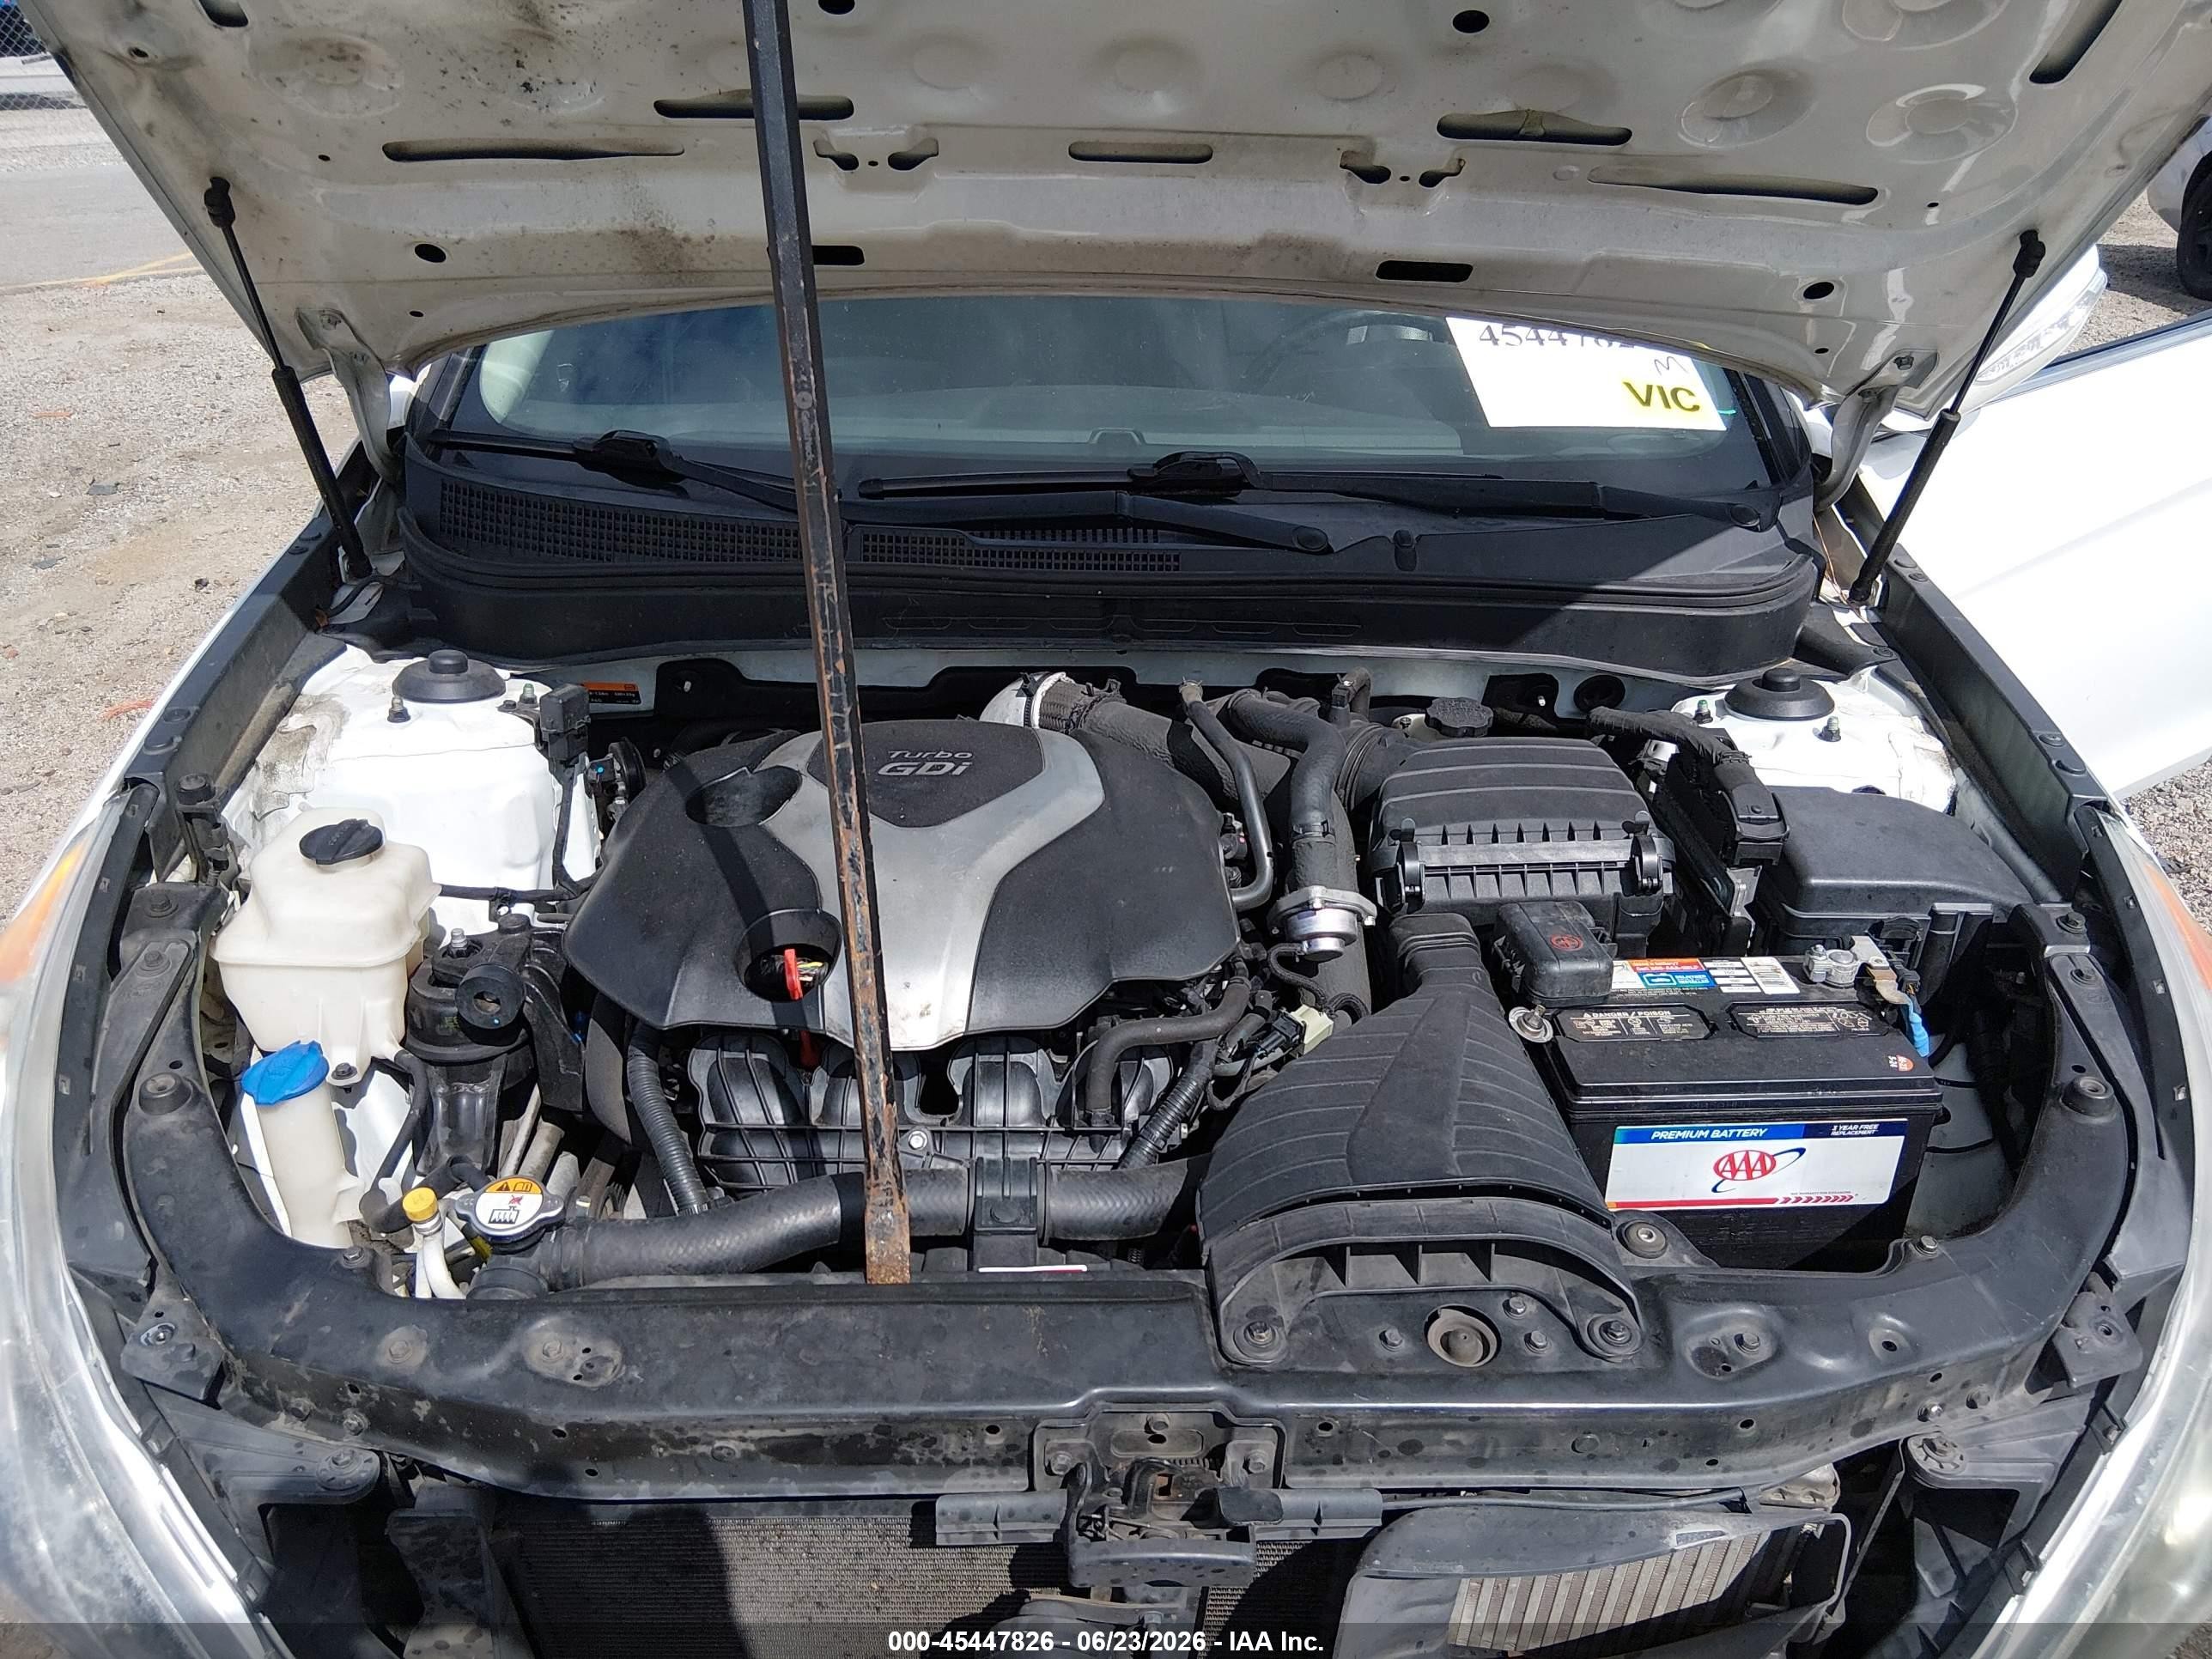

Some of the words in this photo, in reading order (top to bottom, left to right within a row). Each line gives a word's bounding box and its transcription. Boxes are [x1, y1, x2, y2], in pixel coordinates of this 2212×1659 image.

[1623, 381, 1700, 412] VIC
[878, 761, 973, 776] GDi
[1650, 1129, 1710, 1140] PREMIUM
[1711, 1127, 1768, 1139] BATTERY
[1718, 1149, 1771, 1181] AAA
